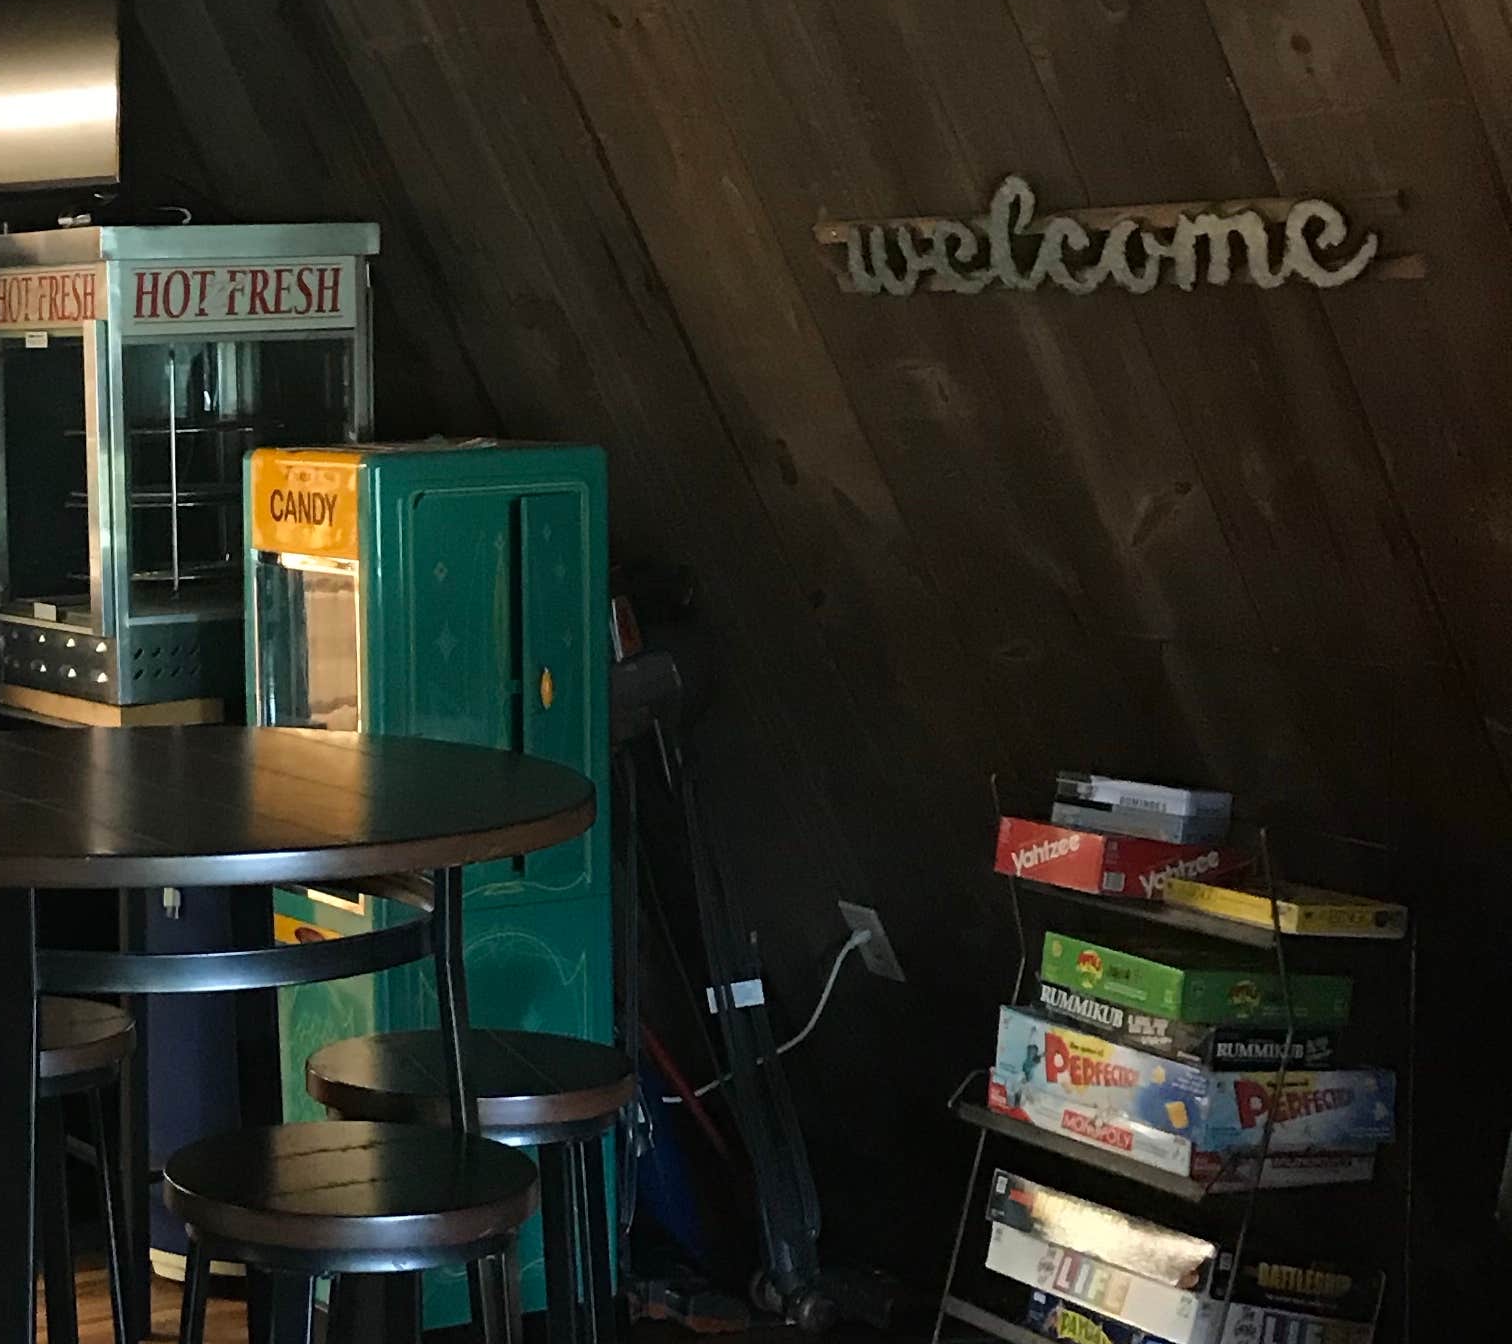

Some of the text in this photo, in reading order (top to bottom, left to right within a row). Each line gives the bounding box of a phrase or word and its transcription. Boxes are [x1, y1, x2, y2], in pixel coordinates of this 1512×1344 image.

[847, 176, 1379, 296] welcome
[38, 273, 96, 321] FRESH
[133, 267, 343, 318] HOT FRESH
[270, 489, 338, 527] CANDY
[1011, 834, 1080, 877] Yahtzee
[1040, 984, 1123, 1028] RUMMIKUB
[1216, 1042, 1304, 1059] RUMMIKUB
[1064, 1113, 1132, 1149] MONOPOLY
